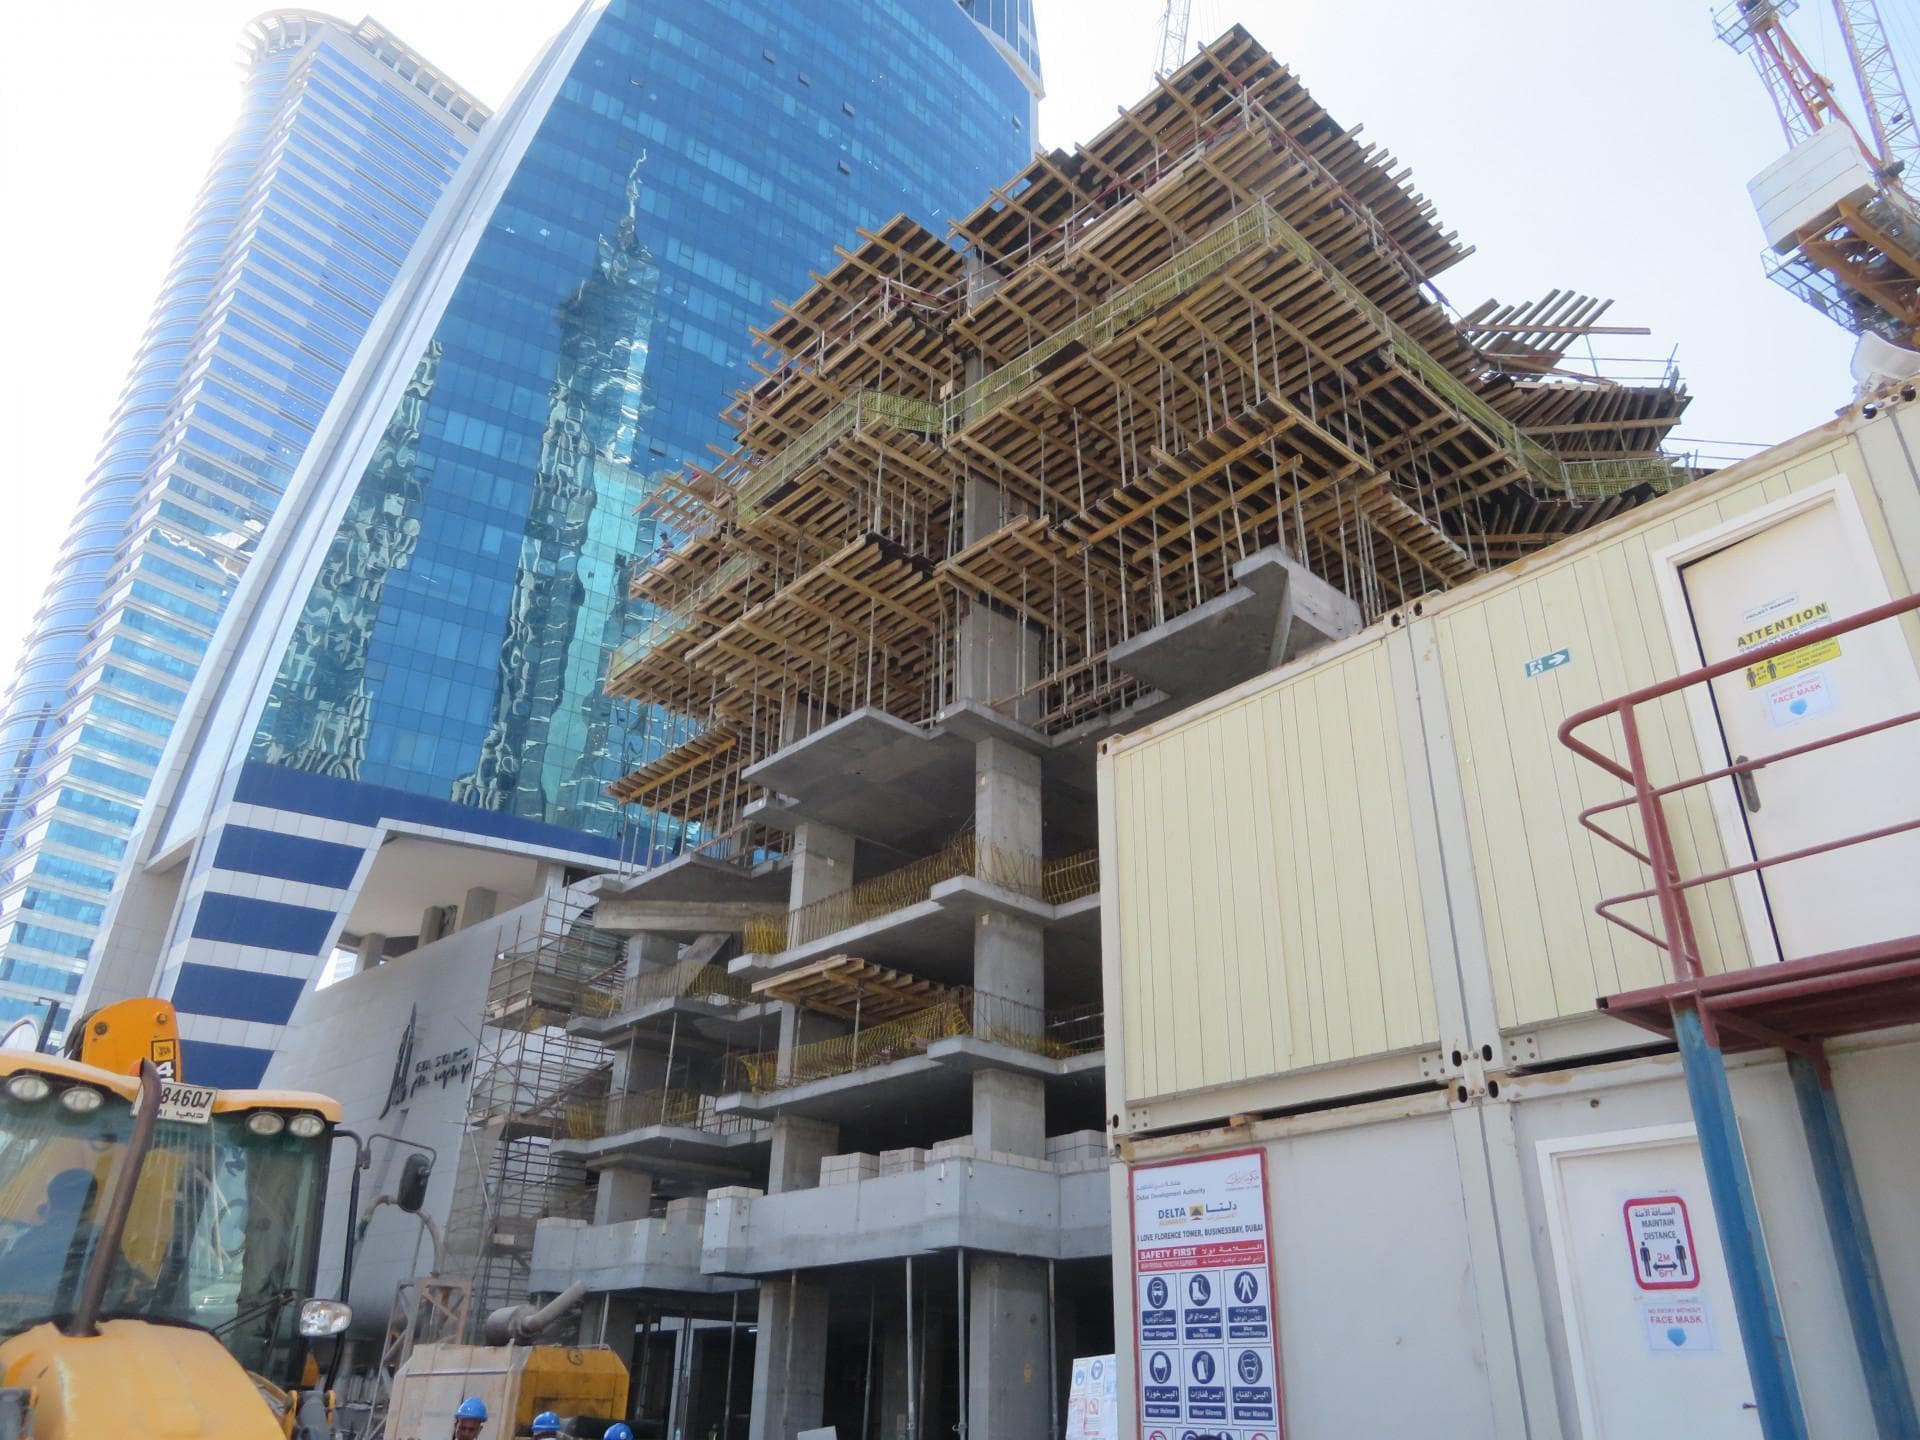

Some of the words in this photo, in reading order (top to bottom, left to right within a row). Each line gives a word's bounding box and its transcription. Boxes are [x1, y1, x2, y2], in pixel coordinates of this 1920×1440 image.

[1737, 602, 1828, 648] ATTENTION
[1773, 693, 1796, 706] FACE
[1796, 682, 1823, 699] MASK
[1158, 1207, 1186, 1219] DELTA
[1245, 1223, 1263, 1233] DUBAI
[1641, 1218, 1675, 1229] MAINTAIN
[1644, 1231, 1677, 1241] DISTANCE
[1141, 1249, 1171, 1260] SAFETY
[1173, 1247, 1197, 1258] FIRST
[1650, 1315, 1673, 1324] FACE
[1676, 1314, 1703, 1324] MASK
